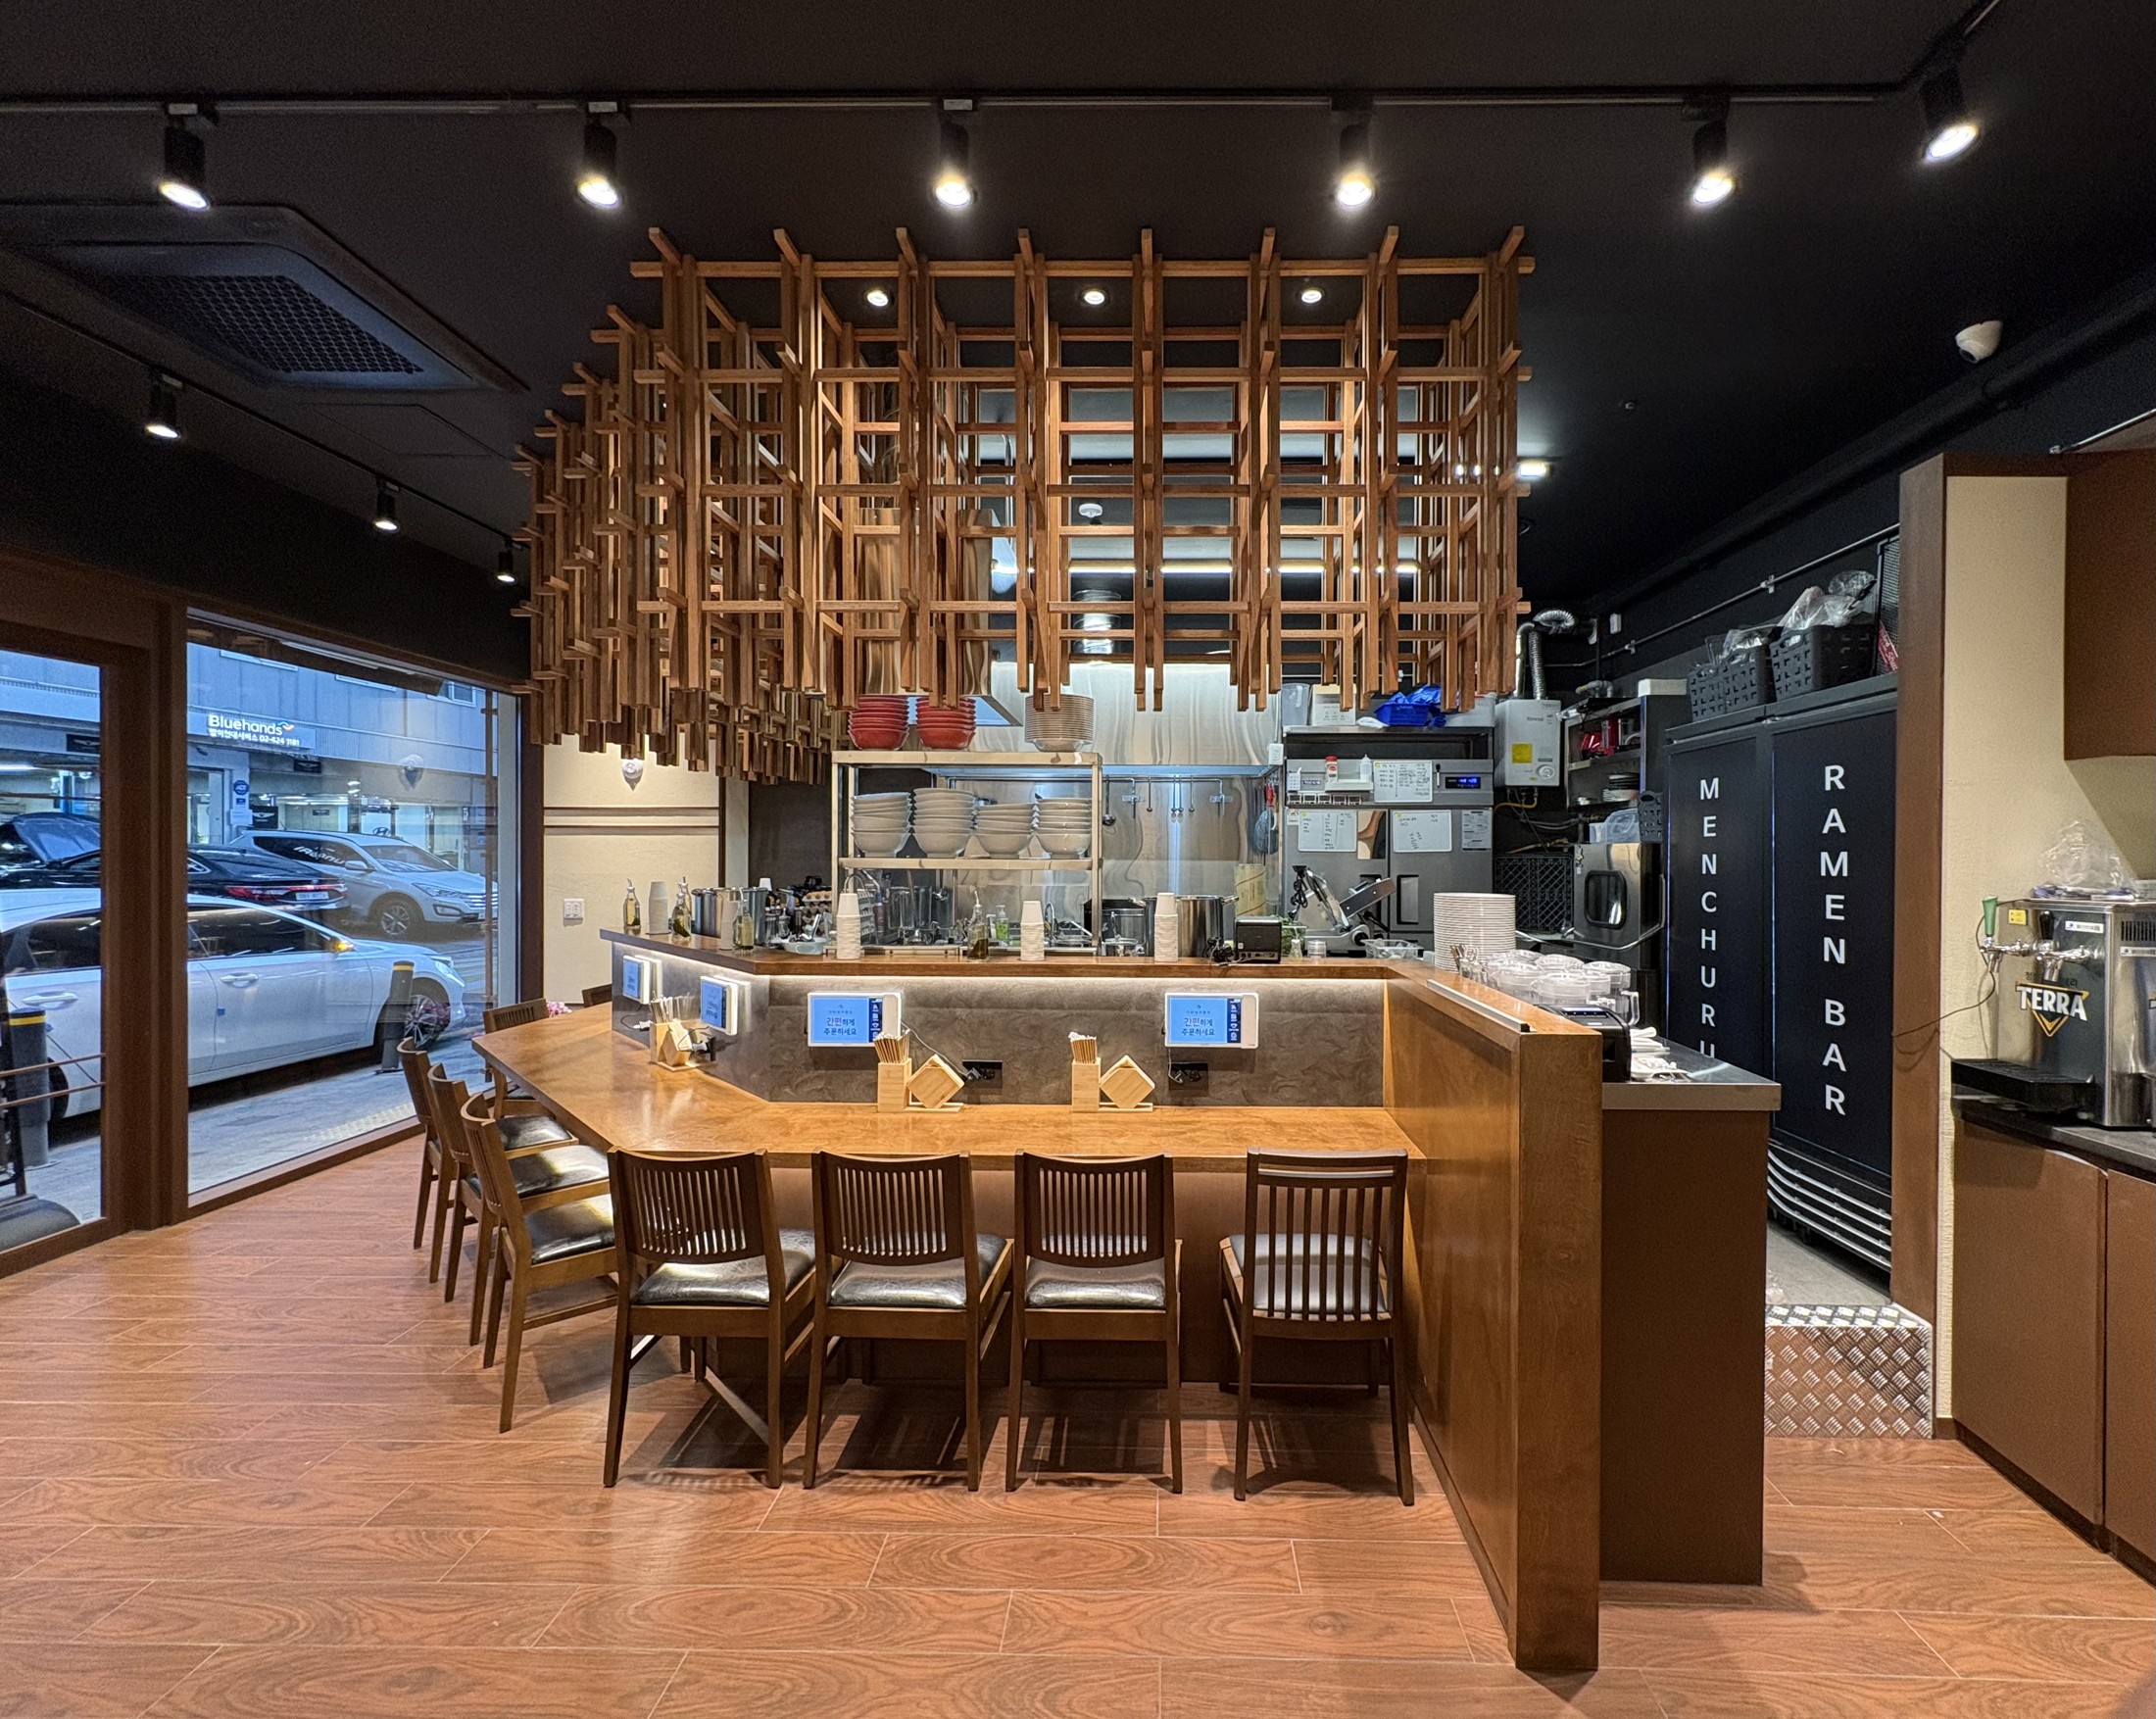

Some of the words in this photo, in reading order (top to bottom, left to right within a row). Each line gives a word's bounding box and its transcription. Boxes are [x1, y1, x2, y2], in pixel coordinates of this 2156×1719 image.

[208, 713, 282, 735] Bluehands
[1820, 764, 1848, 964] RAMEN
[2016, 985, 2087, 1021] TERRA
[826, 1016, 856, 1027] 간편하게
[1184, 1017, 1213, 1027] 간편하게
[823, 1027, 858, 1036] 주문하세요
[1181, 1028, 1215, 1037] 주문하세요
[1822, 999, 1847, 1116] BAR
